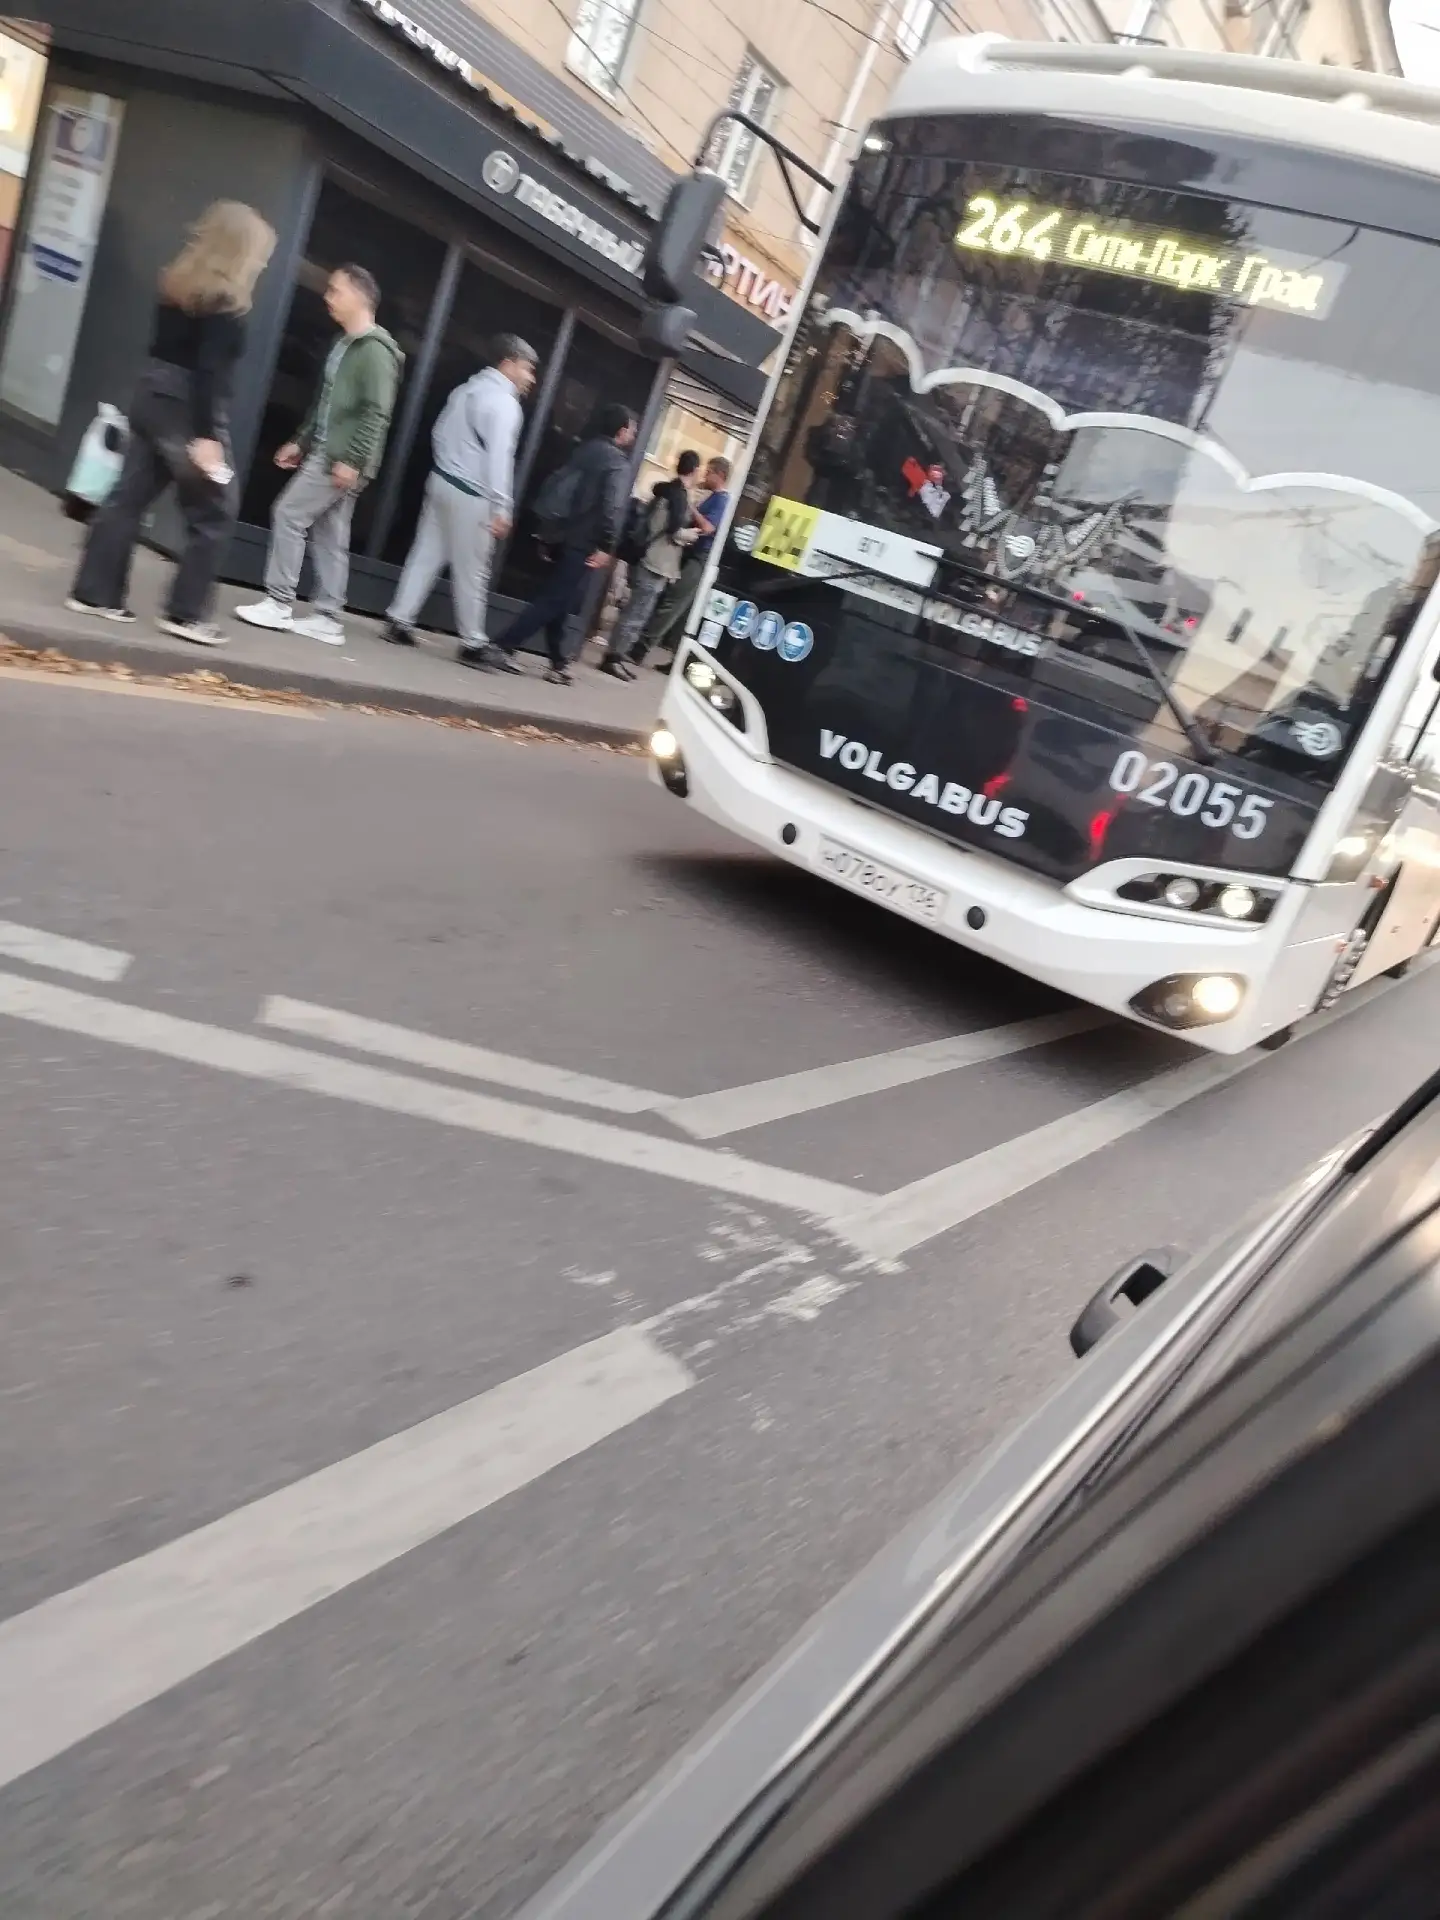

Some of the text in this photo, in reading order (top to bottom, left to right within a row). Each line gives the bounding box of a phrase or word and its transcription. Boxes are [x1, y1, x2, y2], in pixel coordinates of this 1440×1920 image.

[954, 195, 1063, 261] 264
[1063, 222, 1231, 290] Сити-Парк
[818, 728, 1030, 839] VOLGABUS
[1107, 750, 1275, 840] 02055
